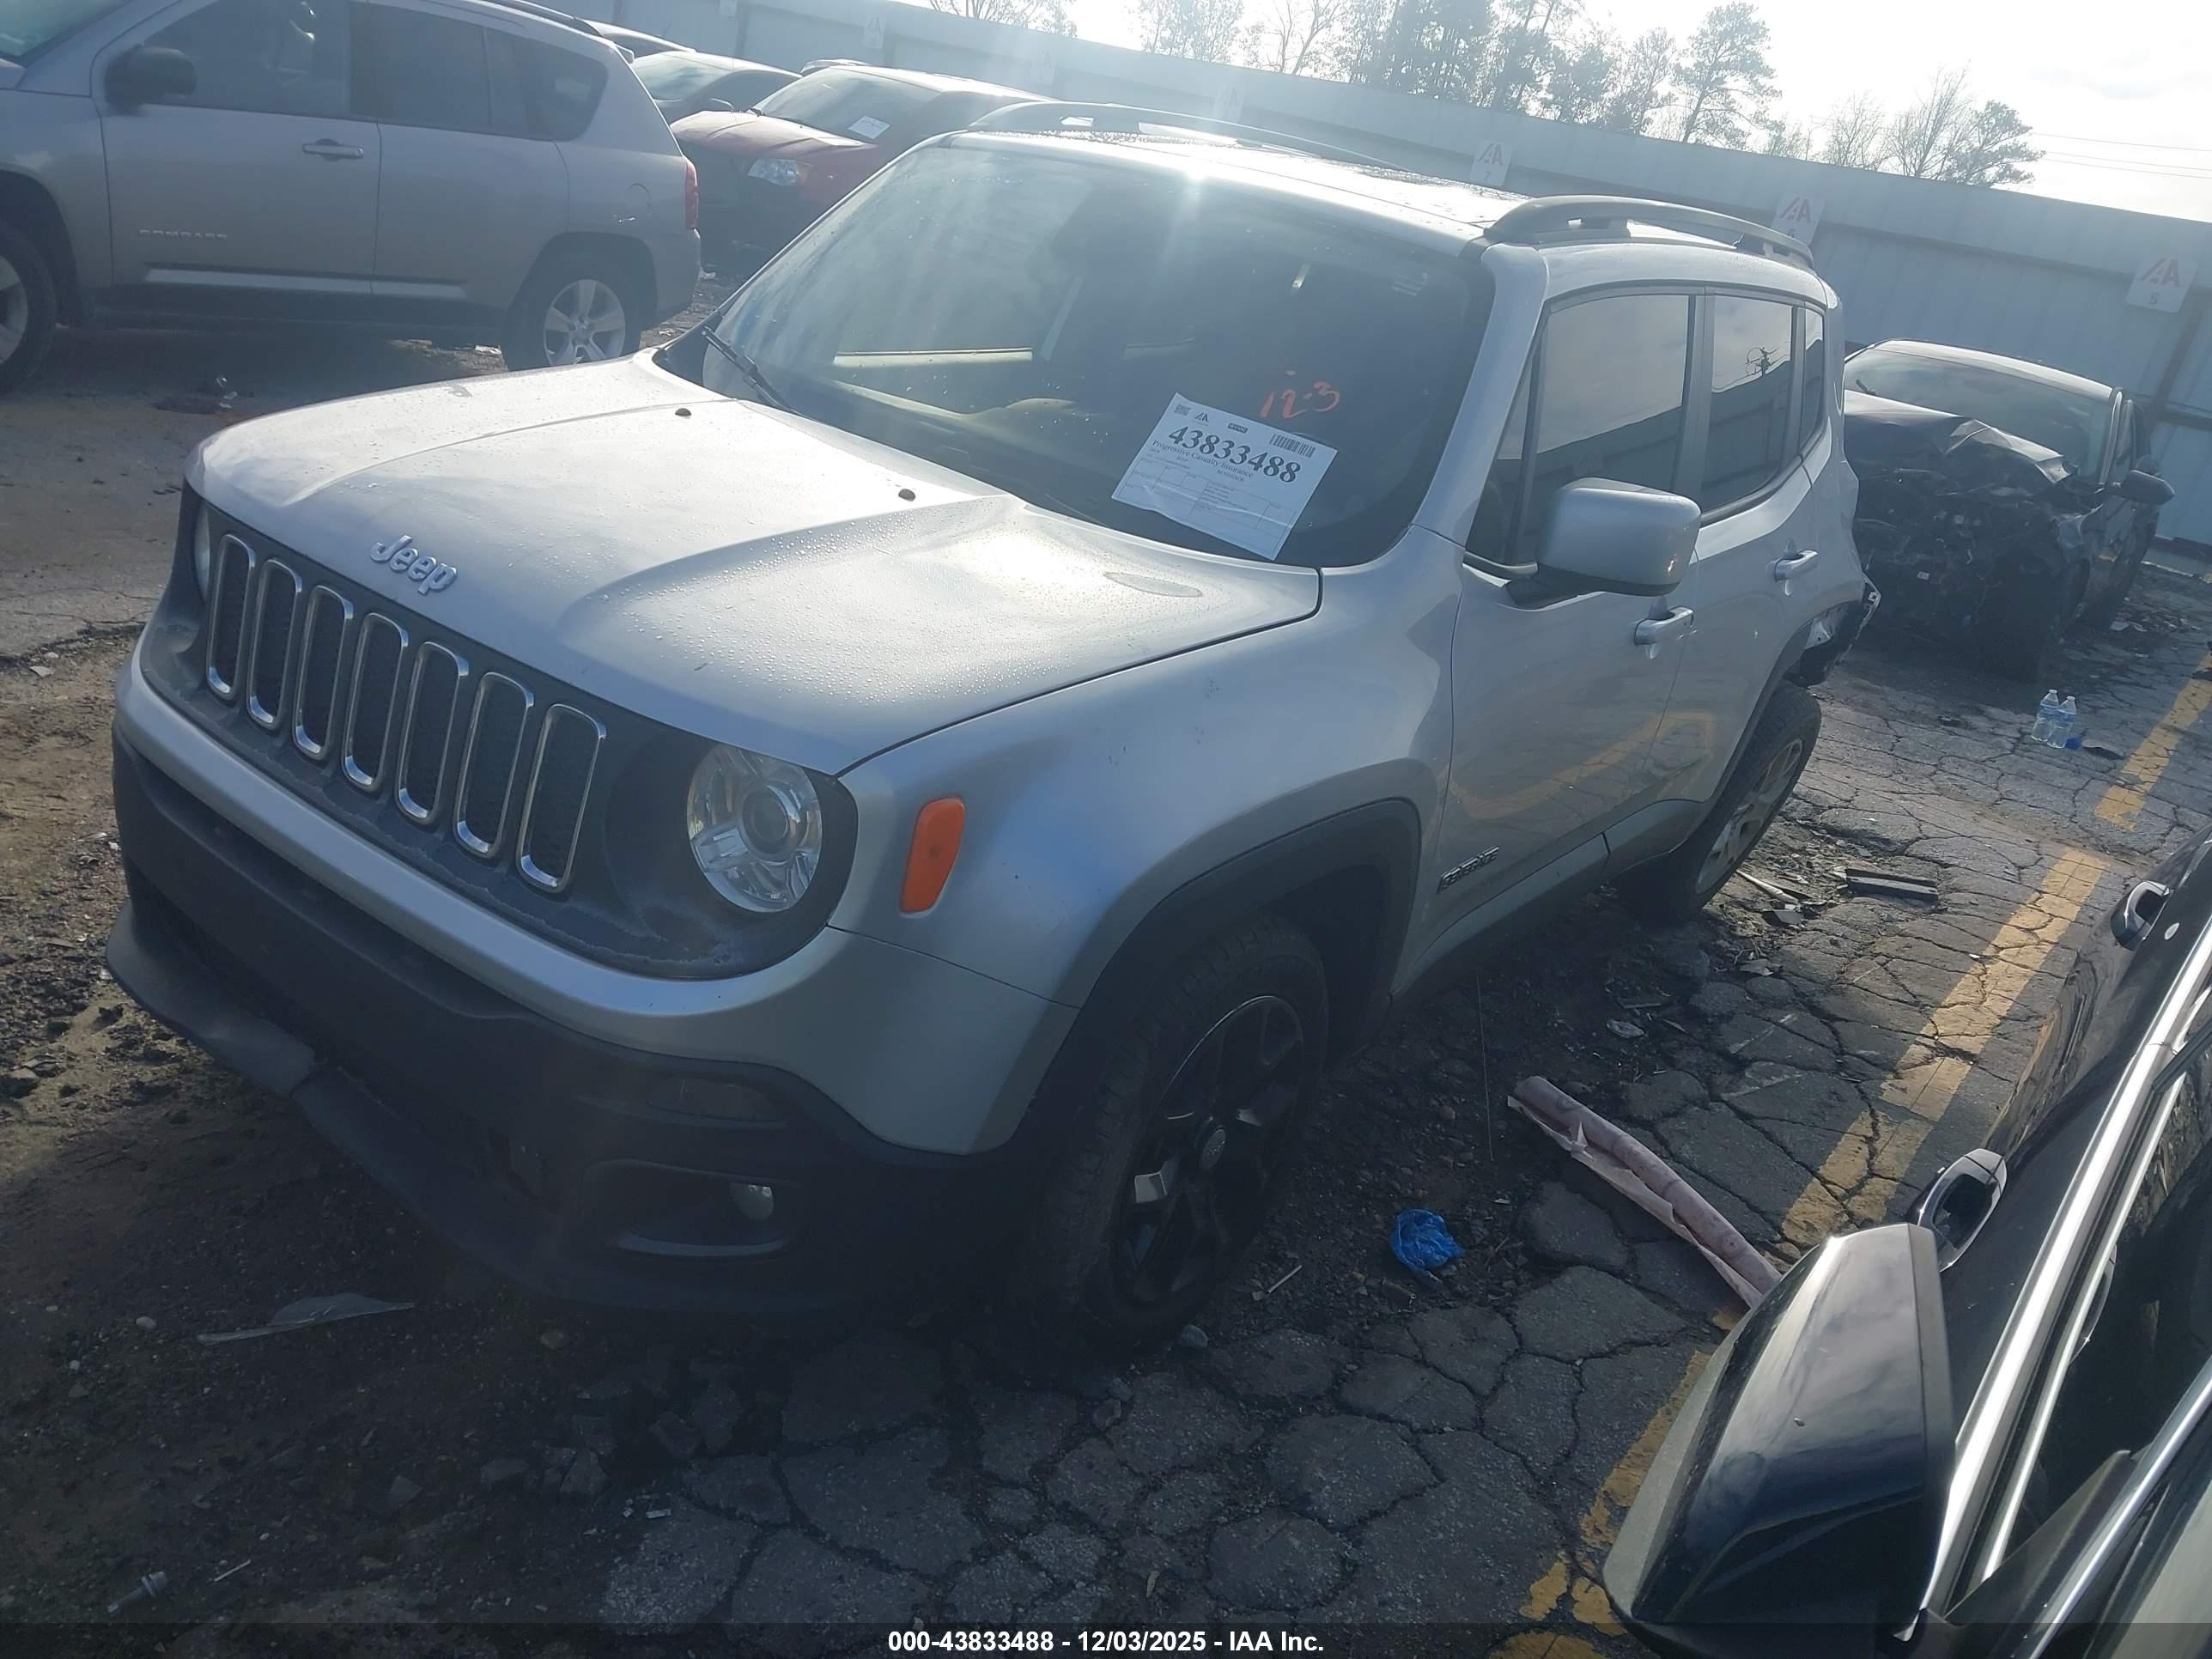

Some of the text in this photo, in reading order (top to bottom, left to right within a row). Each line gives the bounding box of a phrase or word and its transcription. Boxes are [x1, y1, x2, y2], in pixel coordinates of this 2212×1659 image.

[1152, 439, 1192, 457] Progressive
[1191, 452, 1219, 468] Casualty
[1220, 463, 1254, 479] Insurance
[1169, 426, 1301, 483] 43833488
[370, 535, 458, 596] Jeep
